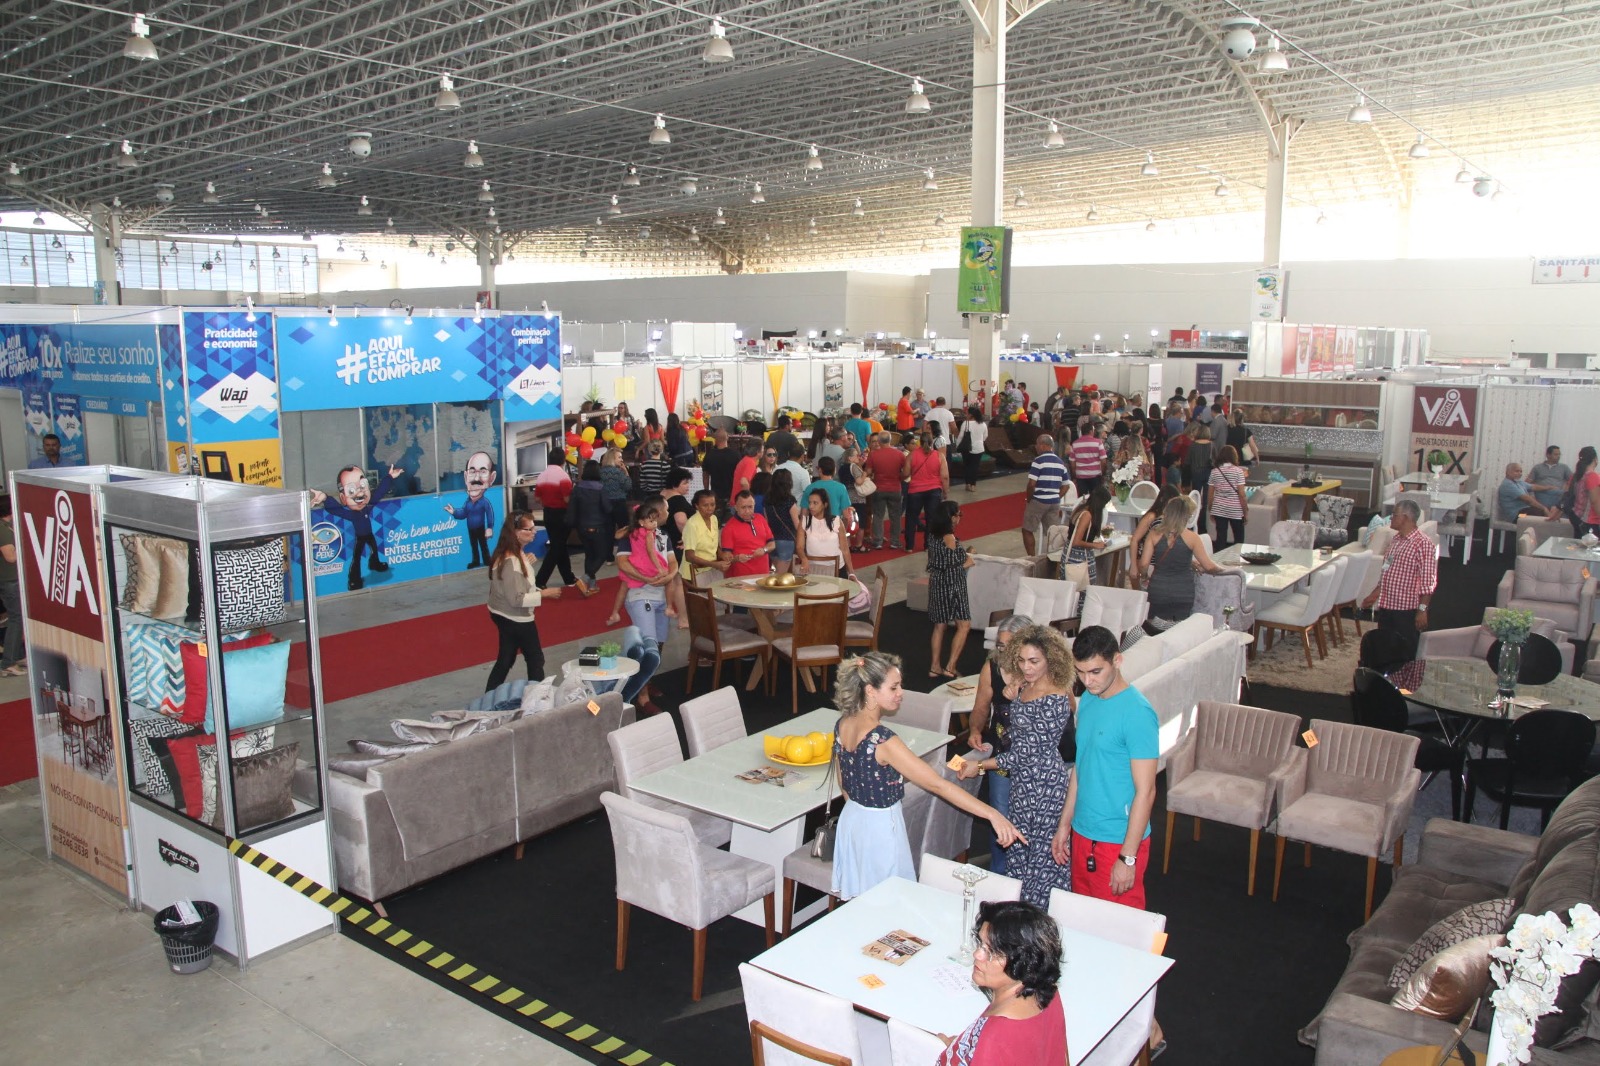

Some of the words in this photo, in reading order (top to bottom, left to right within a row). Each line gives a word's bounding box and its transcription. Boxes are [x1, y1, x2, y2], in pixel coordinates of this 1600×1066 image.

[204, 328, 258, 338] Praticidade
[511, 327, 551, 337] Combinação
[518, 335, 544, 346] perfeita
[97, 346, 117, 365] seu
[118, 340, 155, 366] sonho
[211, 338, 258, 348] economia
[368, 335, 403, 354] AQUI
[38, 339, 63, 369] 10x
[368, 347, 418, 369] EFACIL
[367, 357, 442, 384] COMPRAR
[1435, 401, 1455, 426] DESIGN
[1415, 437, 1449, 447] PROJETADOS
[1449, 440, 1458, 448] EM
[1458, 439, 1469, 448] ATÉ
[386, 528, 408, 546] Seja
[410, 524, 430, 538] bem
[432, 516, 458, 532] vindo
[384, 543, 412, 556] ENTRE
[412, 543, 418, 552] E
[419, 535, 463, 551] APROVEITE
[388, 551, 422, 565] NOSSAS
[423, 545, 460, 559] OFERTAS!
[54, 532, 68, 604] DESIGN
[161, 846, 198, 868] TRUST
